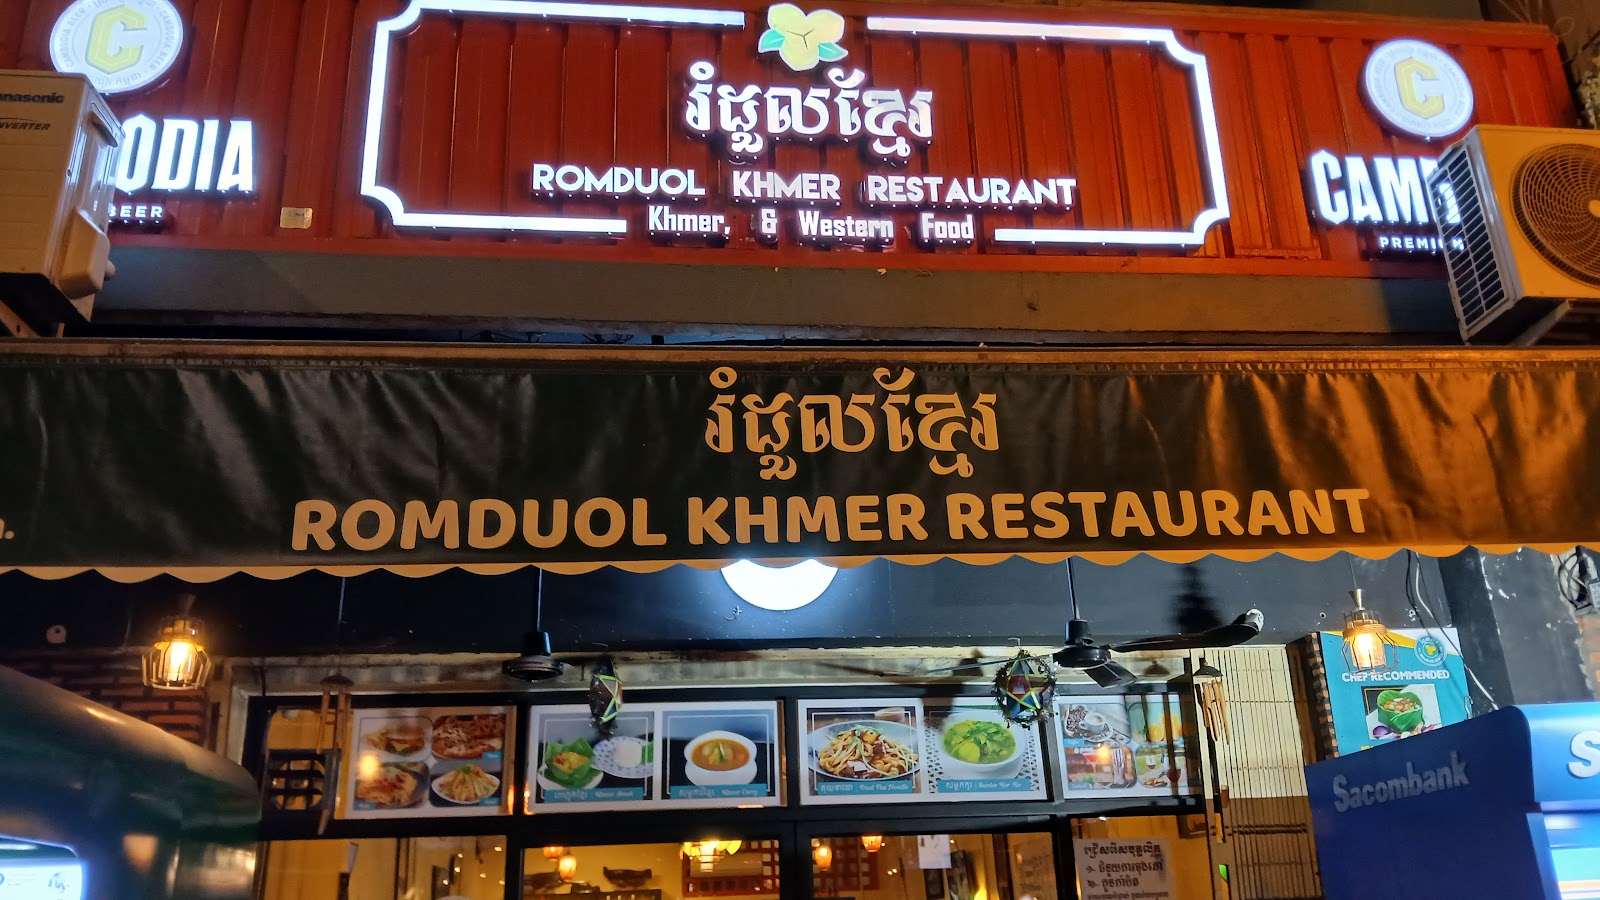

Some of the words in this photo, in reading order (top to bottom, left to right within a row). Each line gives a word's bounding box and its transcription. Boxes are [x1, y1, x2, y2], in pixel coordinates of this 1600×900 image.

[0, 92, 64, 104] nasonic
[532, 163, 706, 197] ROMDUOL
[732, 171, 840, 202] KHMER
[866, 176, 1077, 206] RESTAURANT
[647, 207, 731, 237] Khmer,
[760, 208, 778, 237] &
[798, 210, 894, 240] Western
[921, 213, 975, 240] Food
[704, 366, 999, 480] រំដួលខ្មែរ
[291, 497, 667, 551] ROMDUOL
[688, 494, 928, 544] KHMER
[946, 488, 1370, 540] RESTAURANT
[1371, 669, 1450, 681] RECOMMENDED
[1333, 752, 1470, 812] Sacombank
